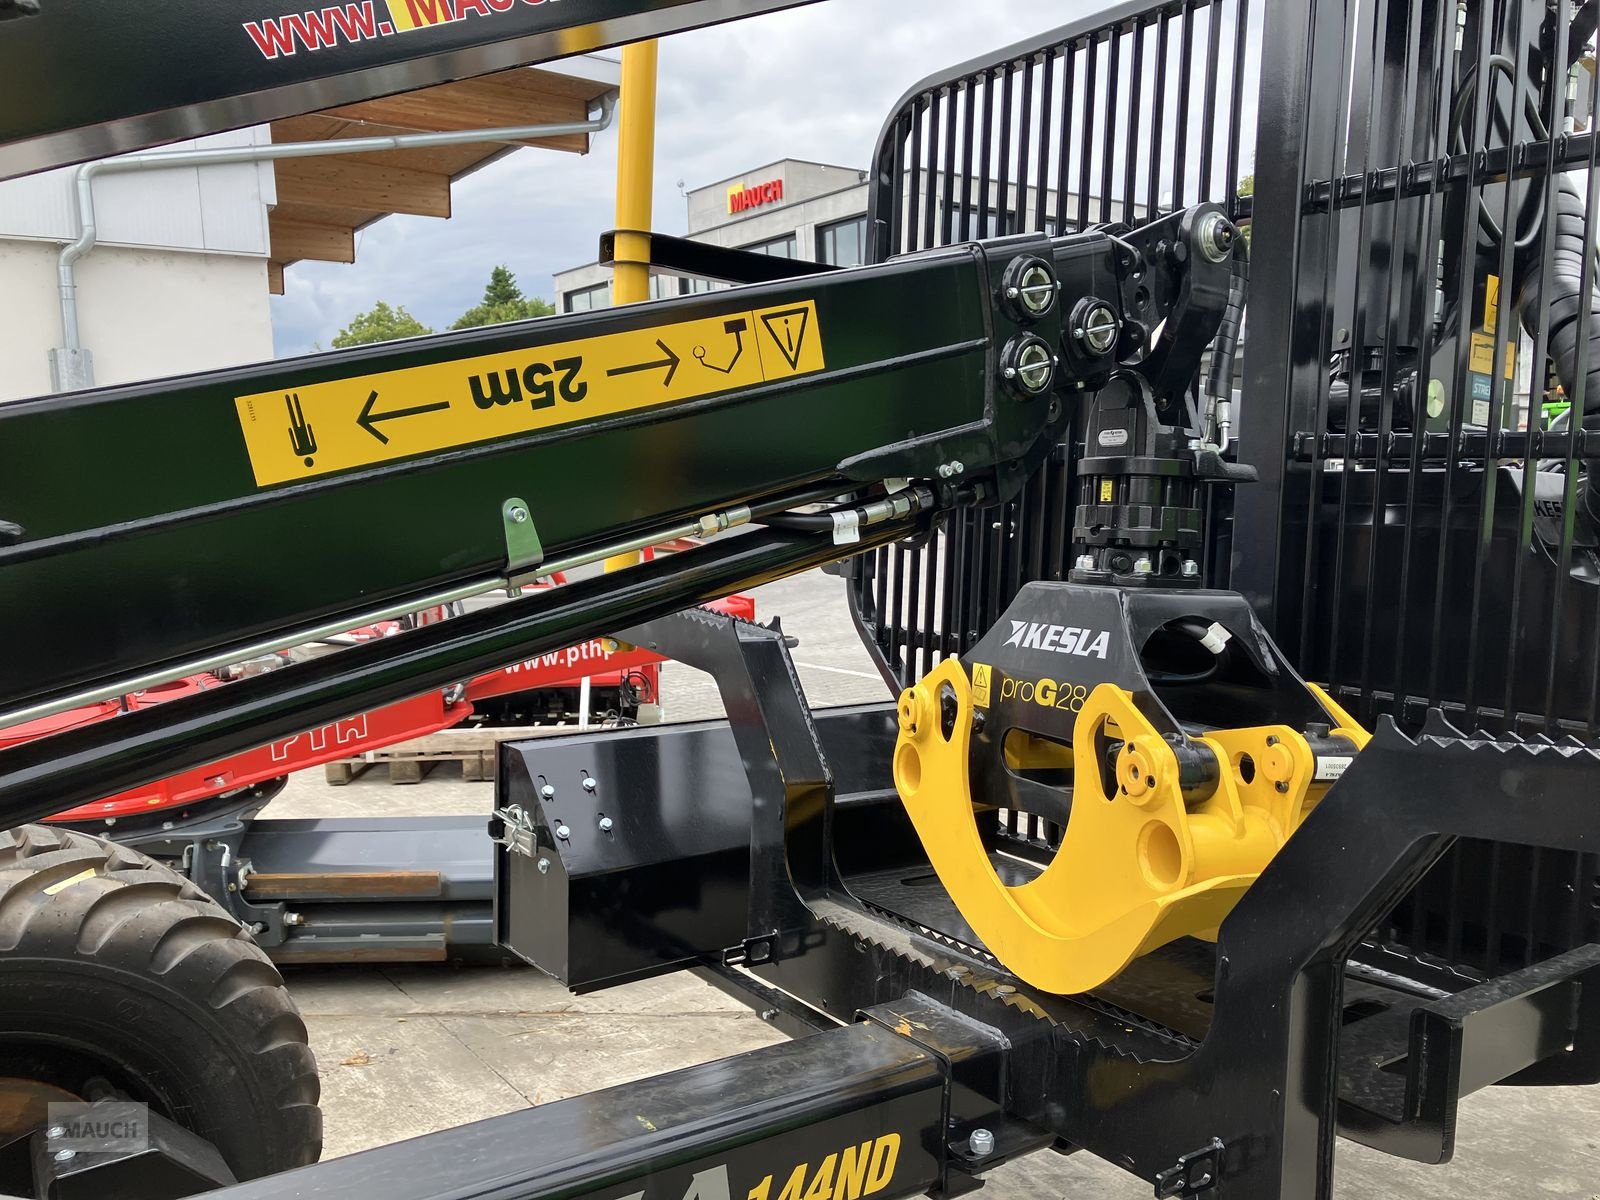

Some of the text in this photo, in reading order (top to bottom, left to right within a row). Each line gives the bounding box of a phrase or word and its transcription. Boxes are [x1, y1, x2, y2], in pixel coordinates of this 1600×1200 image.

[729, 179, 783, 214] MAUCH
[468, 356, 588, 410] 25m
[1022, 622, 1110, 659] KESLA
[1000, 677, 1087, 713] proG28
